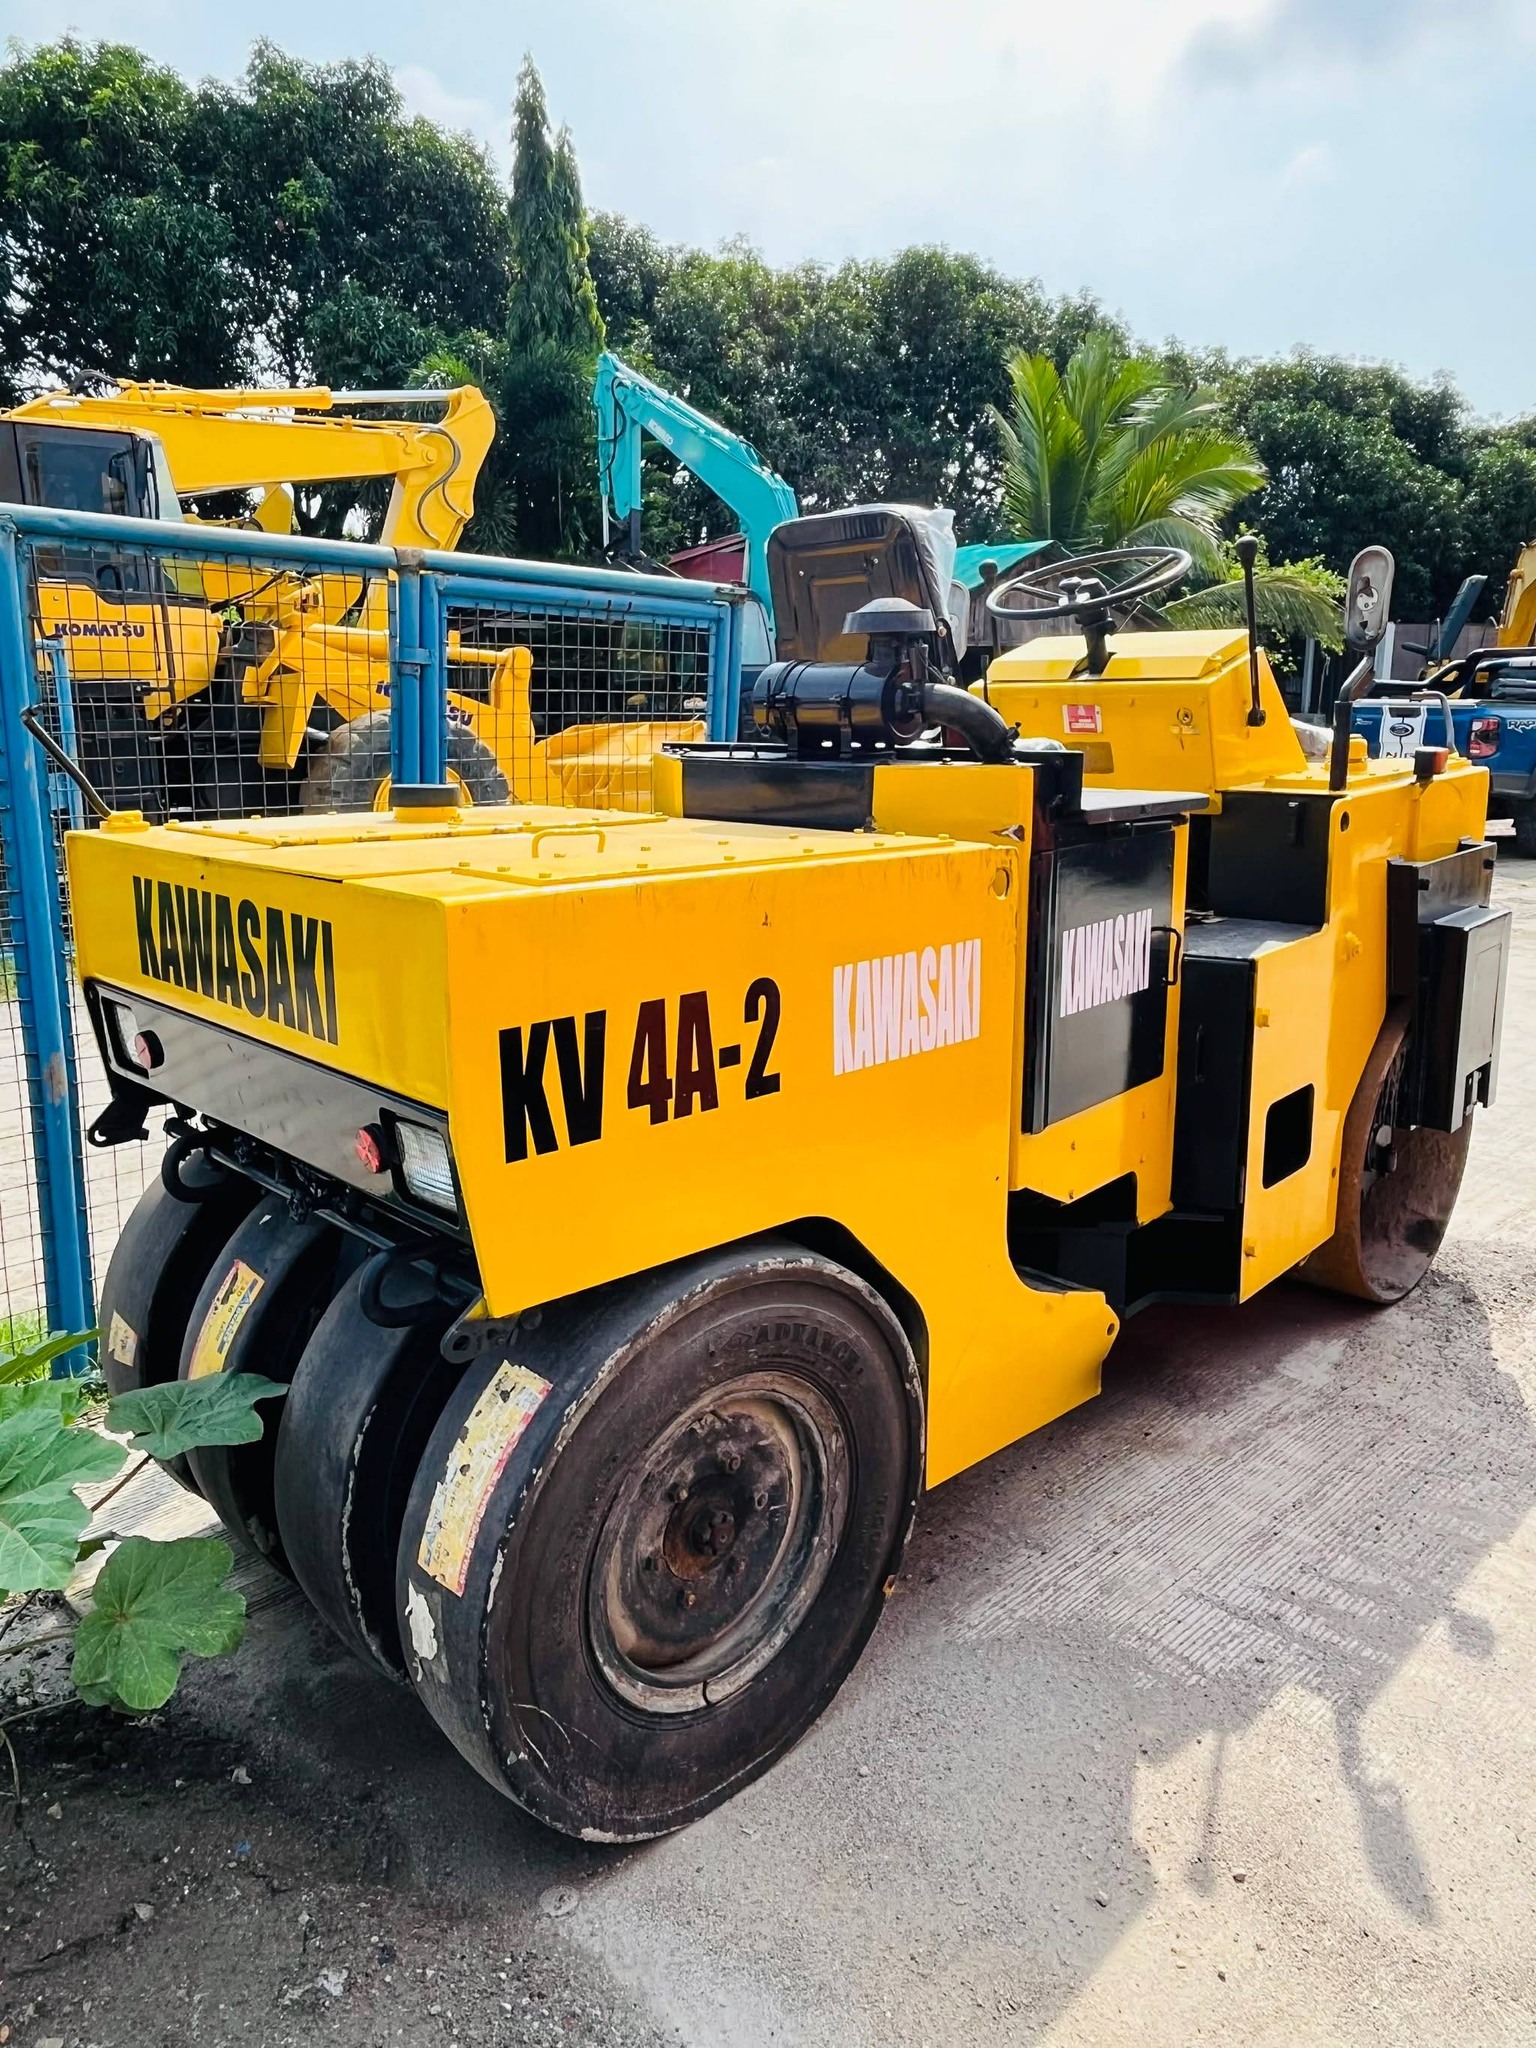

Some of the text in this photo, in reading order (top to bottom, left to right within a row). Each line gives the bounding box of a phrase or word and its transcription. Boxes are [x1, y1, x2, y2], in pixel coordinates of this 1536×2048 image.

[54, 623, 145, 638] KOMATSU
[132, 875, 339, 1046] KAWASAKI
[833, 938, 982, 1076] KAWASAKI
[1060, 908, 1153, 1018] KAWASAKI
[498, 976, 781, 1164] KV 4A-2
